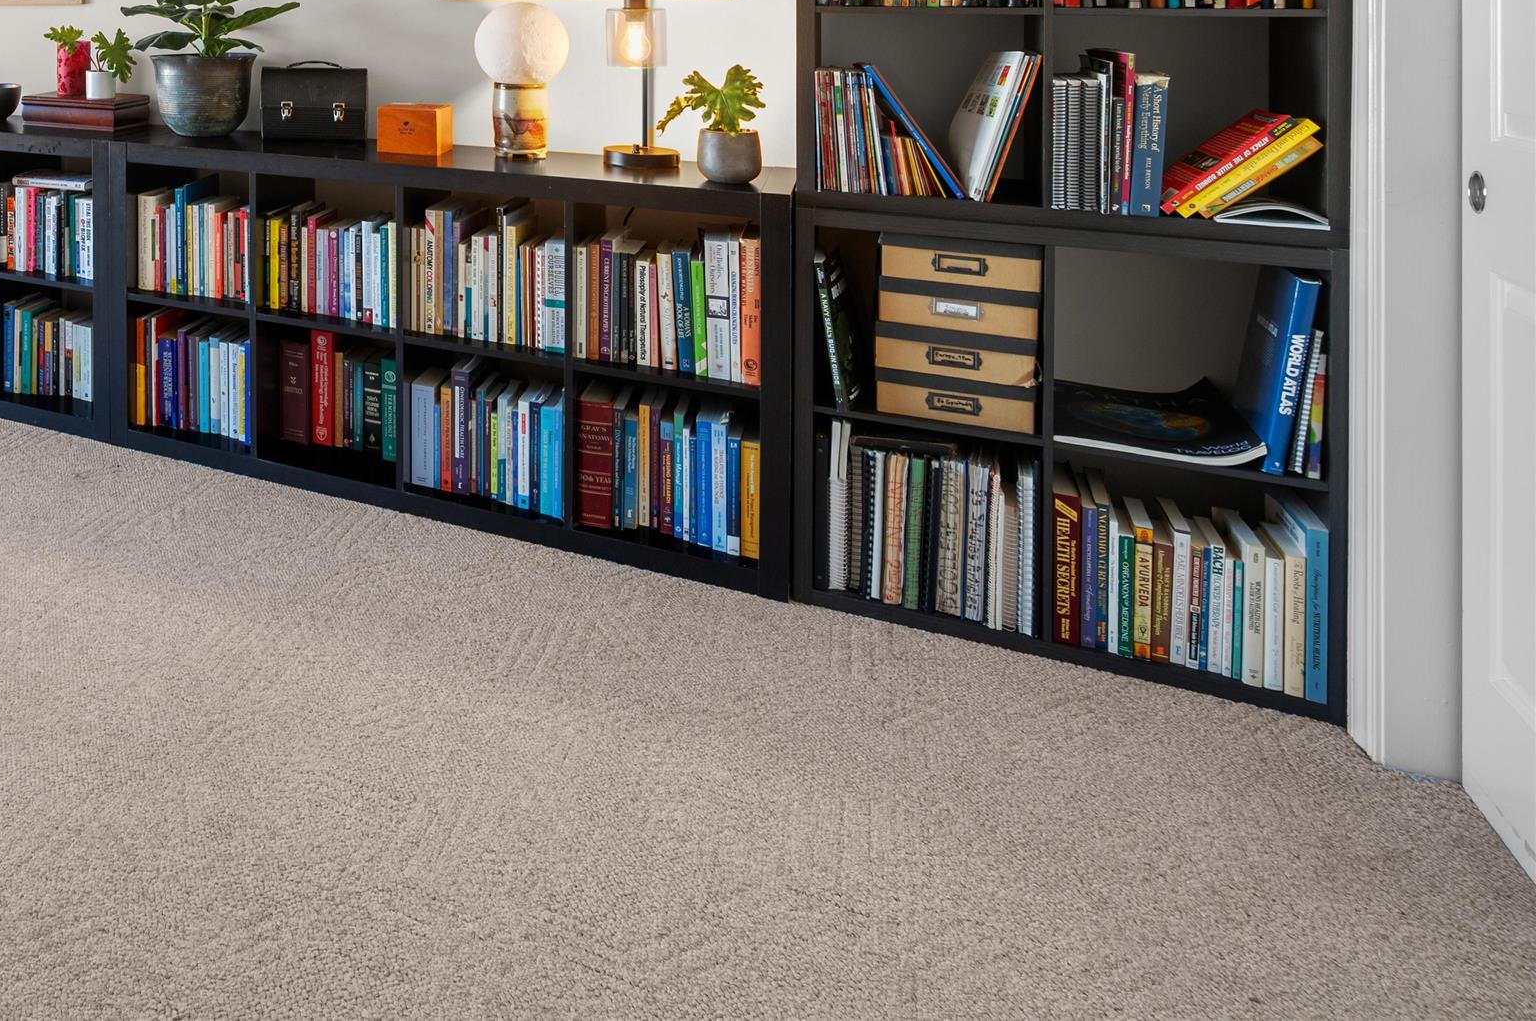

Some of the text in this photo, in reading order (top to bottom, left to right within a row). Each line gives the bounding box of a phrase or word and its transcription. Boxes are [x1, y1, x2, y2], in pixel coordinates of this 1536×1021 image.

[1139, 87, 1152, 150] Nearly Everything
[1152, 94, 1161, 114] Short
[1150, 116, 1161, 141] History
[1276, 137, 1289, 150] and
[1151, 142, 1161, 152] of
[1233, 154, 1244, 165] THE
[1251, 136, 1269, 153] ATTACK
[1144, 170, 1152, 190] BRYSON
[1216, 162, 1233, 176] KILLER
[426, 240, 434, 270] ANATOMY
[554, 255, 565, 270] OUR
[426, 270, 434, 304] COLORING
[547, 255, 555, 295] OURSELVES
[638, 265, 647, 295] Philosophy
[709, 265, 717, 294] Ourselves
[639, 303, 647, 324] Natural
[676, 303, 684, 318] BOOK
[677, 319, 684, 328] OF
[638, 324, 648, 360] Therapeutics
[822, 299, 830, 317] NAVY
[827, 339, 837, 363] BUG-IN
[832, 363, 840, 386] GUIDE
[1285, 334, 1306, 377] WORLD
[1279, 377, 1297, 416] ATLAS
[1097, 507, 1107, 558] UNCOMMON
[1056, 517, 1071, 615] HEALTH SECRETS
[1212, 545, 1224, 576] BACH
[1121, 561, 1130, 599] ORGANON
[1138, 557, 1150, 607] AYURVEDA
[1291, 570, 1304, 625] Roots Healing
[1121, 606, 1129, 642] MEDICINE
[1211, 601, 1221, 628] THERAPY
[1312, 611, 1321, 648] NUTRITIONAL
[1311, 647, 1321, 670] HEALING
